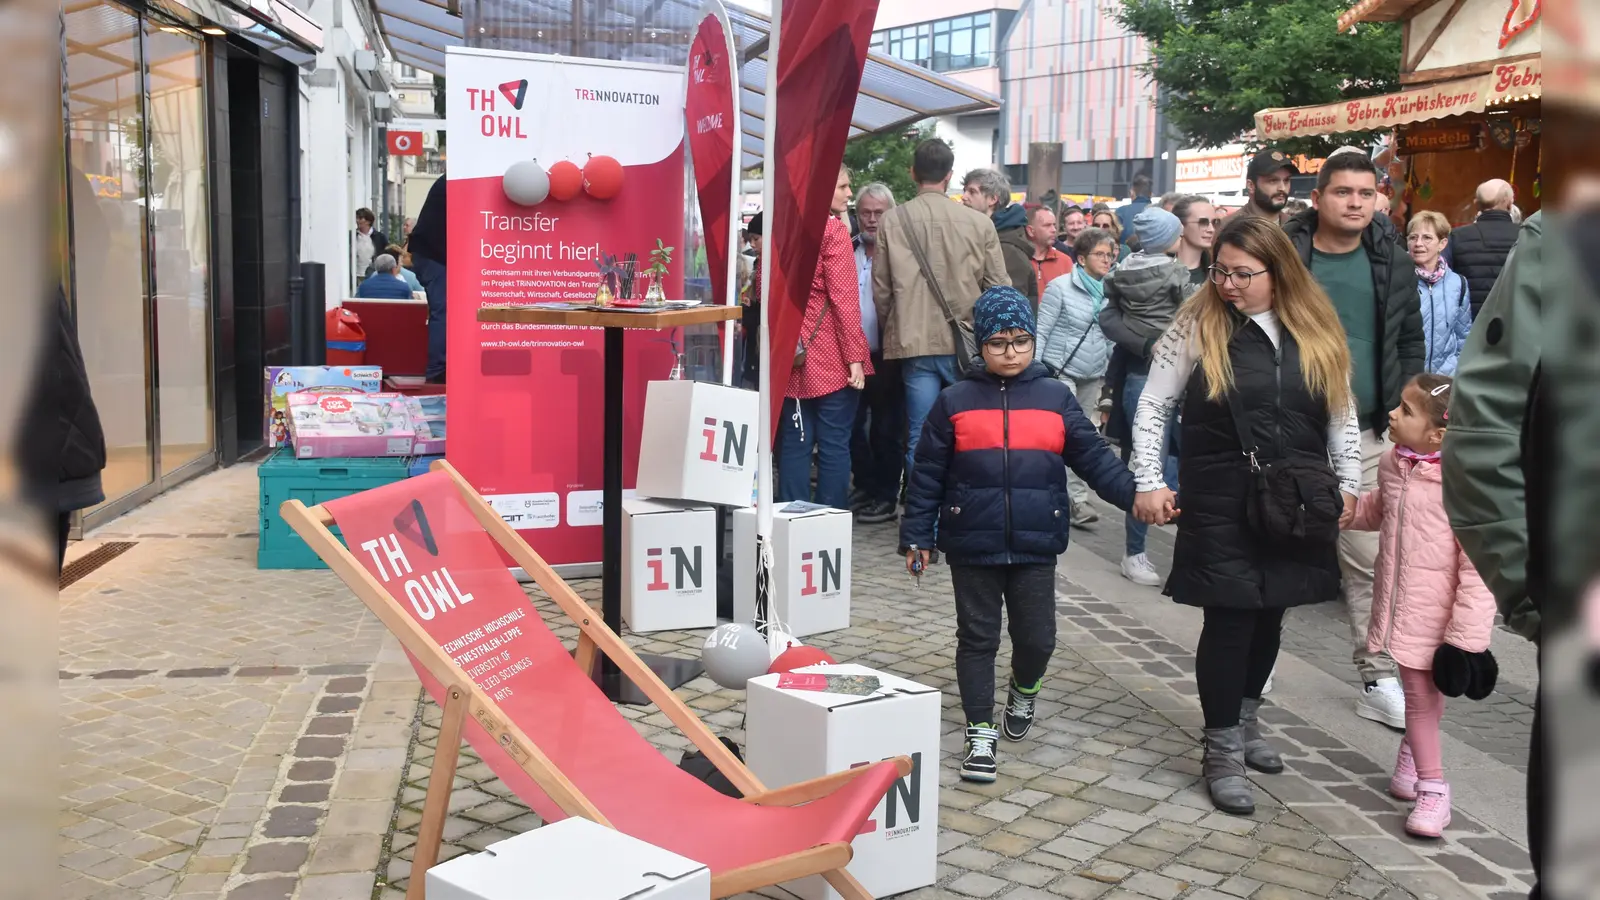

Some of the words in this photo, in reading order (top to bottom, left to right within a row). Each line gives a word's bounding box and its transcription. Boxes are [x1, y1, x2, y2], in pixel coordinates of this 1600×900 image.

[466, 88, 495, 112] TH
[1346, 101, 1381, 125] Gebr.
[1382, 90, 1479, 118] Kürbiskerne
[481, 114, 528, 139] OWL
[1263, 114, 1288, 133] Gebr.
[1288, 109, 1337, 132] Erdnüsse
[1406, 132, 1470, 147] Mandeln
[480, 211, 559, 232] Transfer
[480, 239, 552, 264] beginnt
[559, 241, 600, 261] hier!
[492, 280, 514, 288] Projekt
[553, 270, 600, 278] Verbundpartne
[481, 291, 525, 299] Wissenschaft,
[527, 291, 561, 299] Wirtschaft,
[361, 533, 413, 582] TH
[404, 567, 474, 621] OWL
[484, 607, 526, 634] HOCHSCHULE
[453, 626, 523, 668] STWESTFALEN-LIPPE
[719, 631, 742, 650] TH
[466, 657, 502, 680] IVERSITY
[501, 650, 511, 661] OF
[478, 674, 501, 691] PLIED
[499, 656, 533, 681] SCIENCES
[494, 686, 514, 702] ARTS
